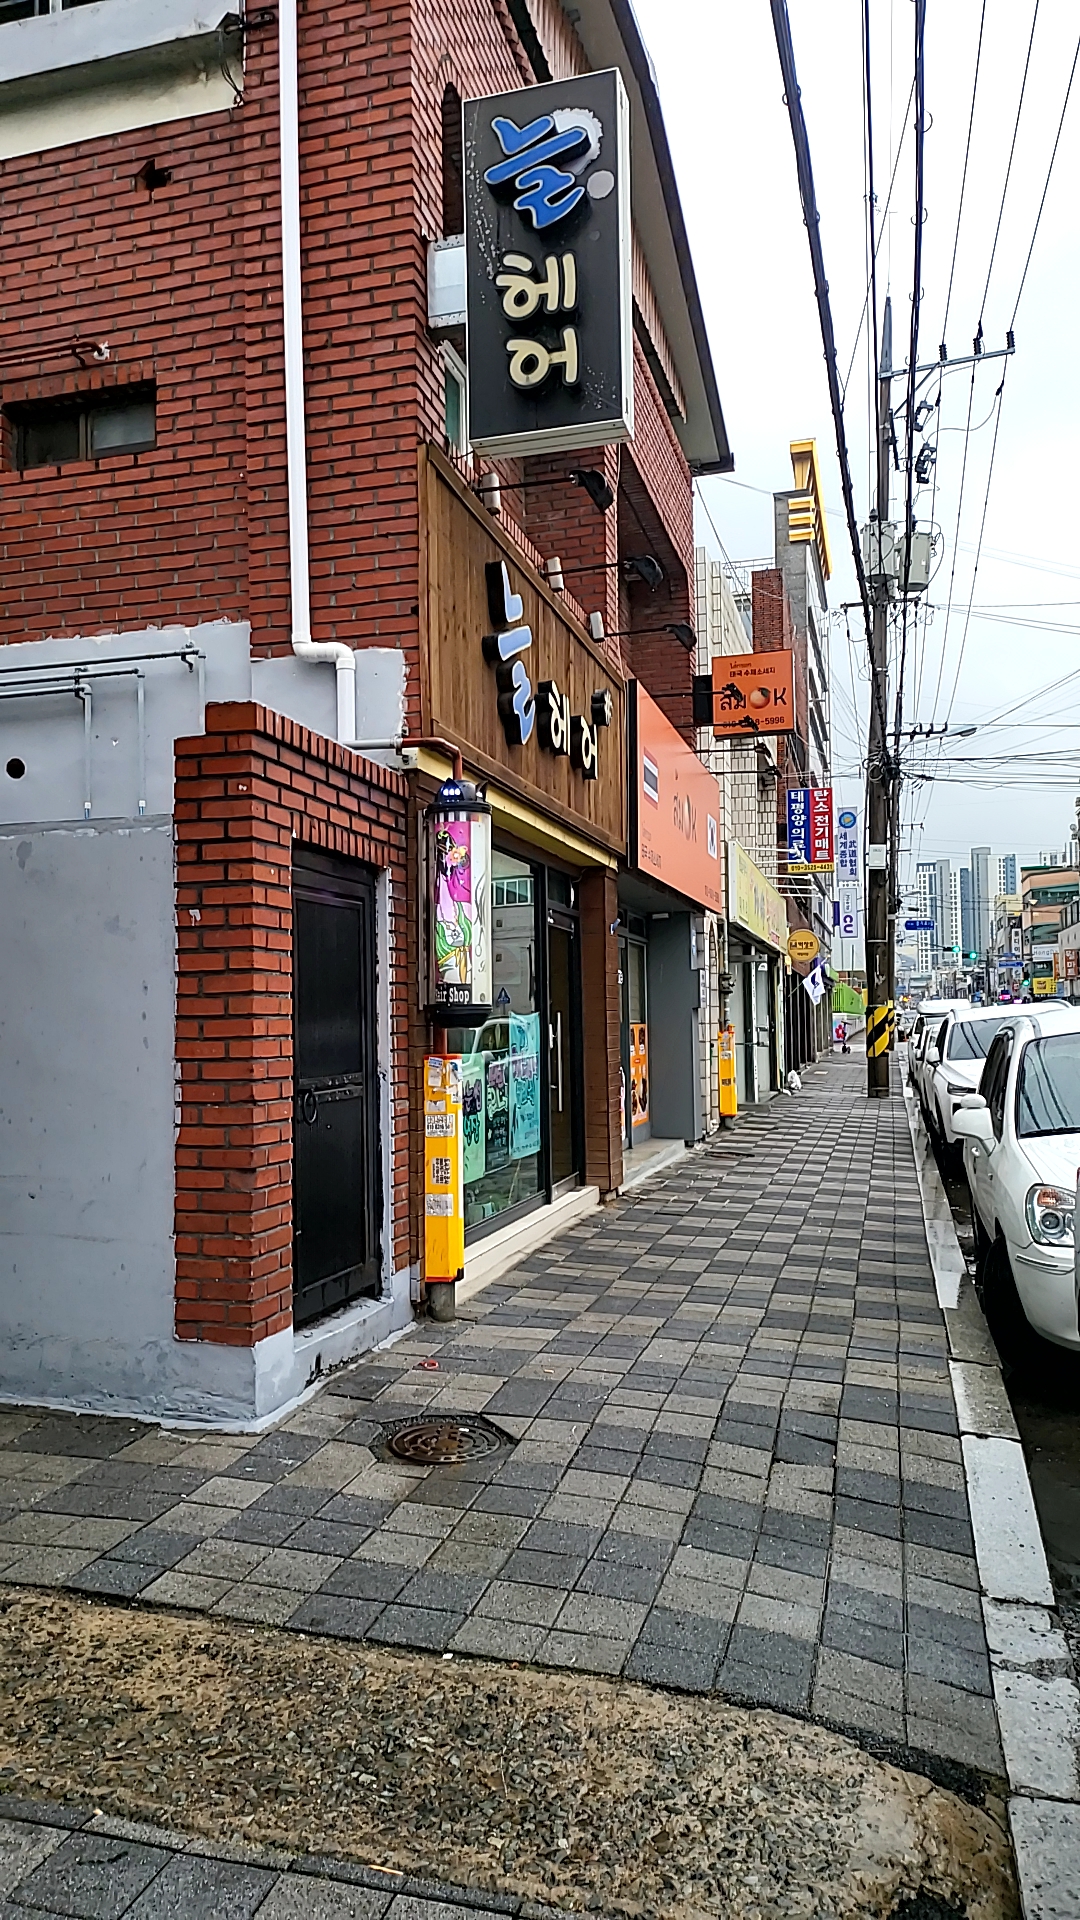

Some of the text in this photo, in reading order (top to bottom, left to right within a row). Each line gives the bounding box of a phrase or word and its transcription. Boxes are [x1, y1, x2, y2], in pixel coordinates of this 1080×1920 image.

[843, 914, 854, 933] CU
[435, 986, 470, 1005] air Shop
